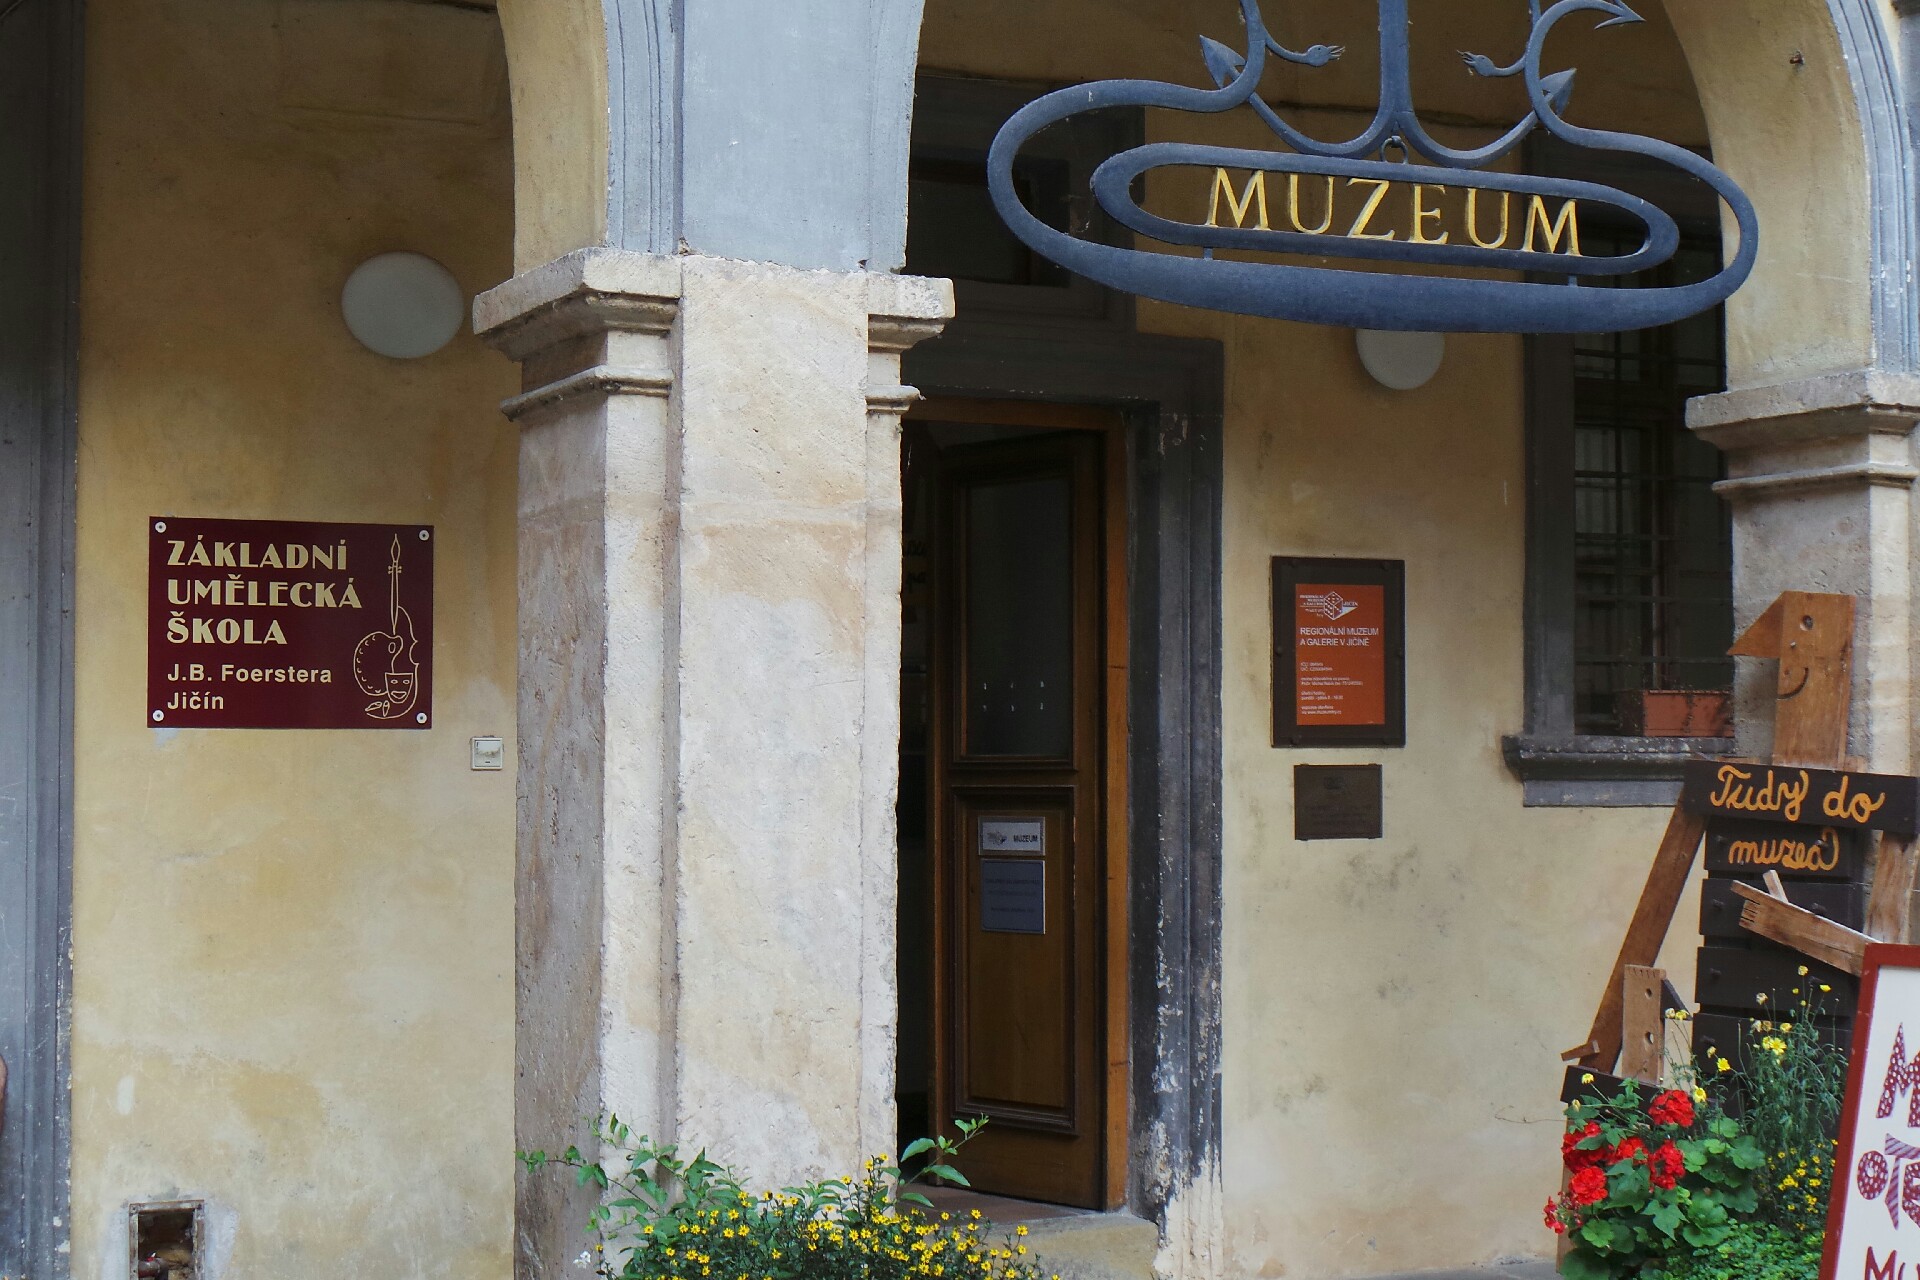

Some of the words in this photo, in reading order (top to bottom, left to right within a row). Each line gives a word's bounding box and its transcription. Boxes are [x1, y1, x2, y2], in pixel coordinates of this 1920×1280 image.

[1204, 166, 1582, 257] MUZEUM
[167, 535, 347, 570] ZÁKLADNÍ
[167, 574, 363, 609] UMĚLECKÁ
[166, 611, 288, 645] ŠKOLA
[1300, 626, 1345, 636] REGIONÁLNÍ
[1347, 627, 1379, 636] MUZEUM
[1300, 638, 1305, 646] A
[1307, 638, 1338, 646] GALERIE
[167, 664, 212, 682] J.B.
[221, 664, 332, 683] Foerstera
[167, 692, 224, 710] Jičín
[1710, 765, 1809, 822] Tudy
[1823, 775, 1886, 823] do
[1728, 827, 1840, 871] muzea
